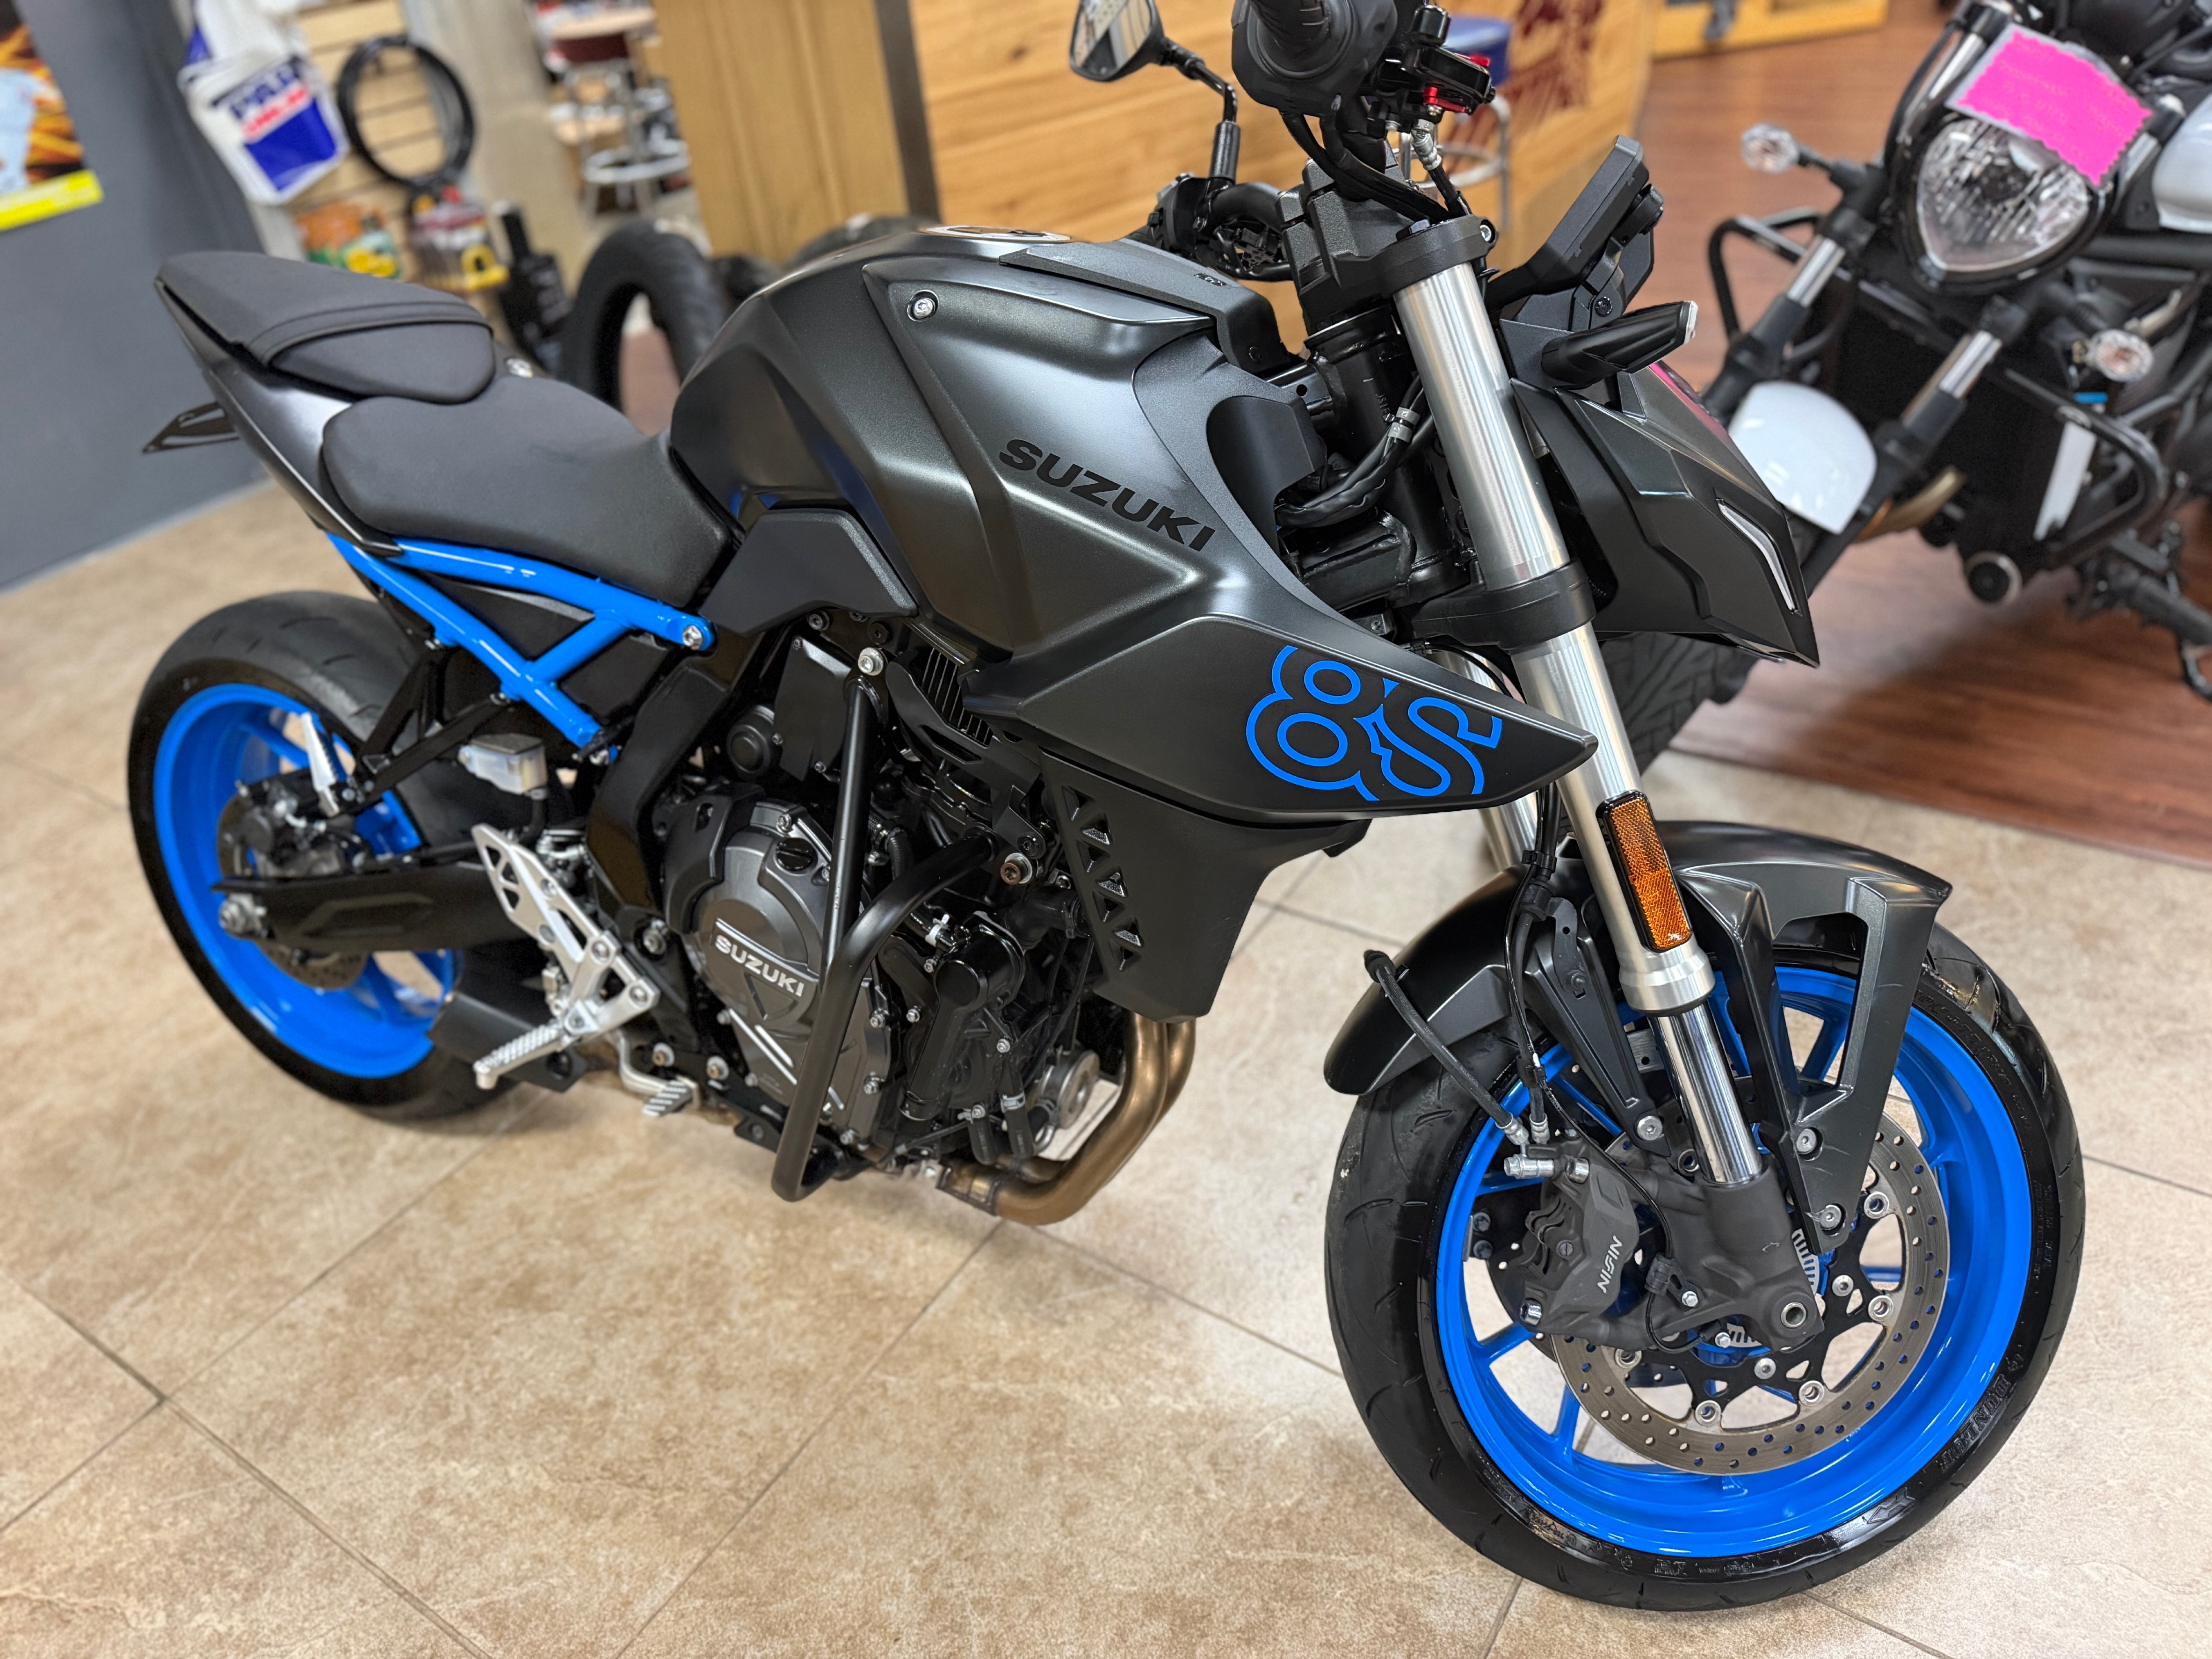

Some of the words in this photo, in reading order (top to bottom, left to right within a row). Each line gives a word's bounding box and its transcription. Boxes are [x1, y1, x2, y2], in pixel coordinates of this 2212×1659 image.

[999, 439, 1216, 552] SUZUKI
[715, 935, 805, 997] SUZUKI
[1596, 1235, 1623, 1294] NISSIN
[1935, 1374, 2013, 1473] DUNLOP
